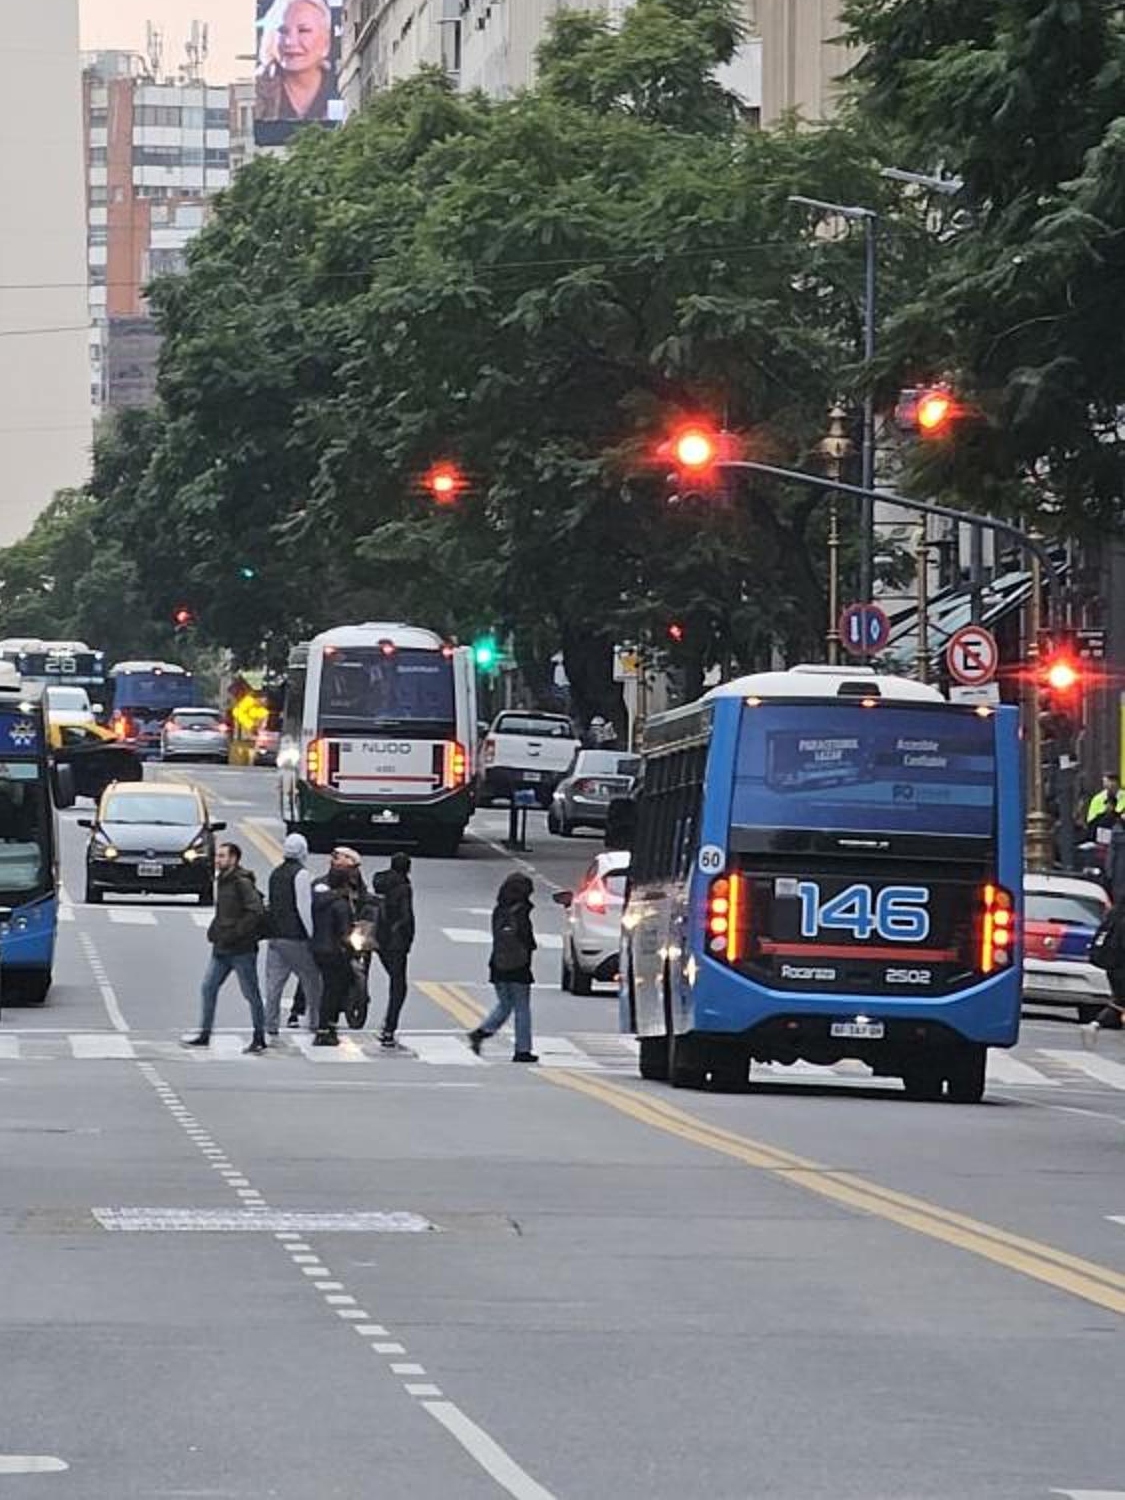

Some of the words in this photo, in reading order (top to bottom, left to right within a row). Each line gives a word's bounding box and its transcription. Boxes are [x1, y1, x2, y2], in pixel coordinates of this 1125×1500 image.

[962, 641, 982, 670] E
[44, 657, 77, 673] 28
[702, 851, 721, 868] 60
[797, 881, 930, 941] 146
[885, 968, 931, 984] 2502
